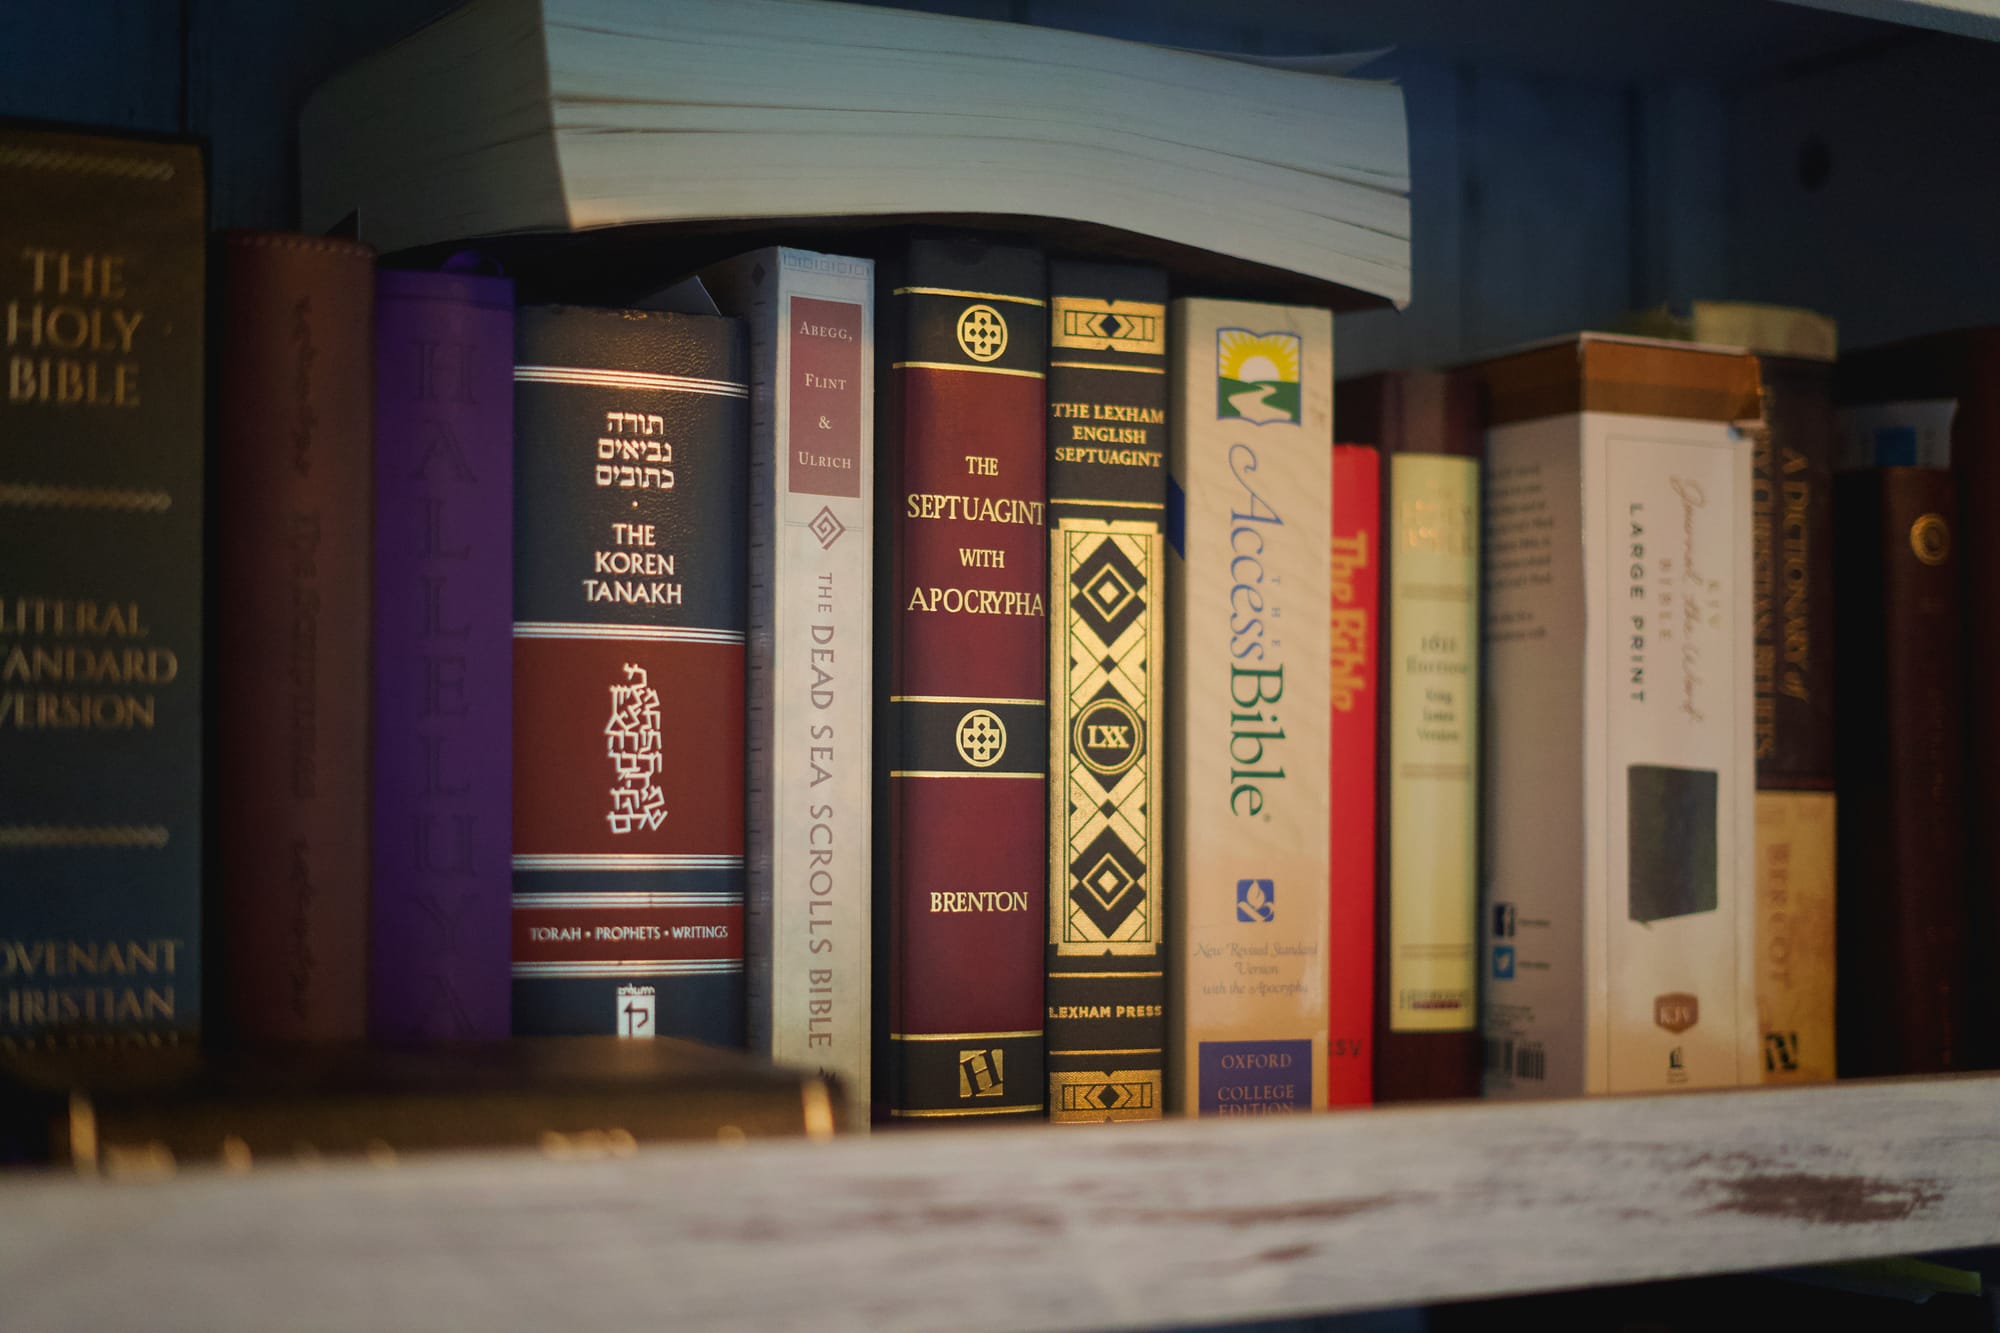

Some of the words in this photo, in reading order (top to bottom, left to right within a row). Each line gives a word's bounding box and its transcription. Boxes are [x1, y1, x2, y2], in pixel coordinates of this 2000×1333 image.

[21, 248, 127, 297] THE
[7, 298, 145, 353] HOLY
[9, 355, 141, 408] BIBLE
[607, 411, 664, 435] תורה
[818, 414, 832, 430] &
[1052, 402, 1090, 420] THE
[1094, 404, 1165, 425] LEXHAM
[1072, 426, 1147, 446] ENGLISH
[598, 438, 672, 463] נביאים
[1055, 446, 1162, 468] SEPTUAGINT
[595, 464, 675, 489] כתובים
[965, 455, 999, 477] THE
[907, 493, 1045, 526] SEPTUAGINT
[611, 523, 657, 547] THE
[594, 551, 675, 576] KOREN
[958, 548, 1006, 569] WITH
[1629, 502, 1646, 600] LARGE
[582, 579, 682, 605] TANAKH
[817, 572, 833, 613] THE
[907, 586, 1045, 617] APOCRYPHA
[1270, 575, 1281, 648] THE
[810, 624, 834, 710] DEAD
[1629, 615, 1646, 704] PRINT
[1087, 724, 1129, 749] LXX
[810, 724, 834, 788] SEA
[808, 804, 834, 955] SCROLLS
[930, 891, 1029, 913] BRENTON
[530, 926, 582, 942] TORAH
[594, 926, 661, 941] PROPHETS
[671, 924, 729, 940] WRITINGS
[807, 968, 833, 1048] BIBLE
[1048, 1005, 1111, 1019] LEXHAM
[1116, 1004, 1163, 1018] PRESS
[1221, 1053, 1293, 1070] OXFORD
[1217, 1084, 1296, 1102] COLLEGE
